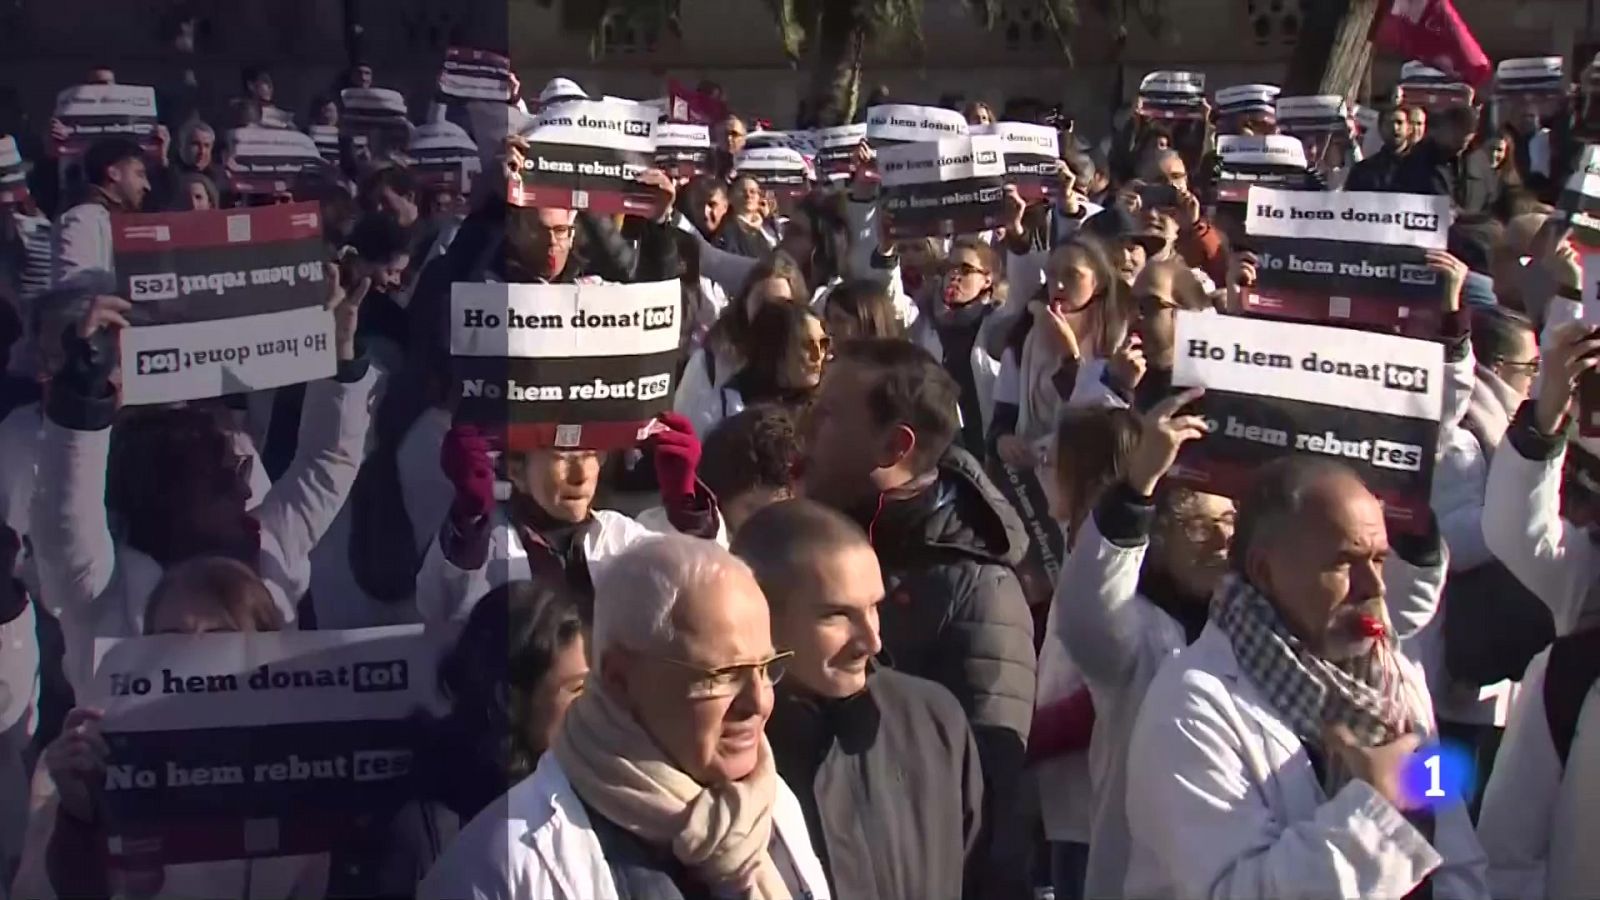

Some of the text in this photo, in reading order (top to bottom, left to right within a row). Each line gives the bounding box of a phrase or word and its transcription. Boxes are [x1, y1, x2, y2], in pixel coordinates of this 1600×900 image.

[577, 115, 622, 131] donat
[625, 120, 650, 136] tot
[538, 157, 574, 173] hem
[578, 161, 621, 177] rebut
[1256, 204, 1438, 232] Ho hem donat tot
[130, 261, 324, 300] No hem rebut res
[1288, 254, 1334, 273] hem
[1338, 260, 1396, 279] rebut
[464, 306, 674, 330] Ho hem donat tot
[137, 333, 328, 375] Ho hem donat tot
[1188, 340, 1428, 393] Ho hem donat tot
[462, 374, 670, 401] No hem rebut res
[1224, 415, 1288, 447] hem
[1295, 431, 1373, 461] rebut
[1373, 440, 1422, 471] res
[109, 660, 408, 696] Ho hem donat tot
[104, 763, 157, 792] No
[166, 760, 244, 788] hem
[253, 754, 349, 784] rebut
